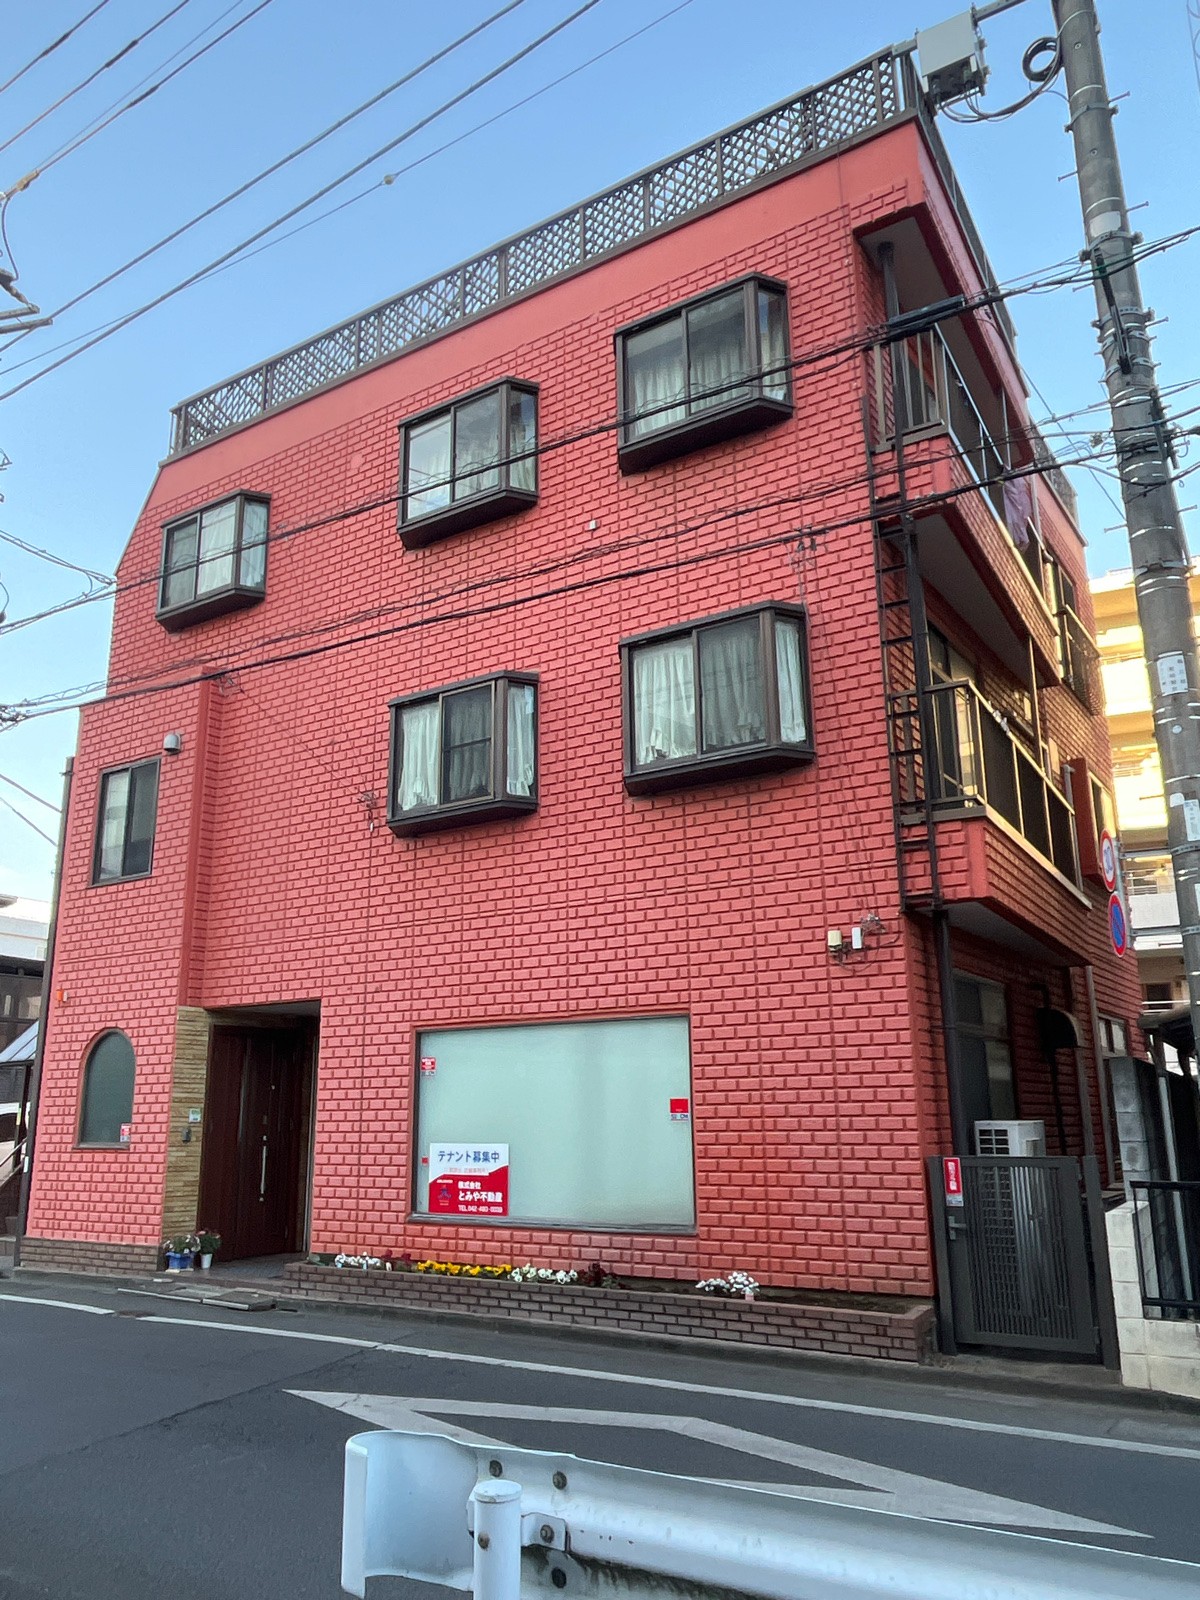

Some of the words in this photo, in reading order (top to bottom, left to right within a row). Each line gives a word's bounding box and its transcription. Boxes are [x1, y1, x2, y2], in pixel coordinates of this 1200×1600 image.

[438, 1150, 500, 1163] テナント募集中
[458, 1191, 503, 1203] とみや不動産
